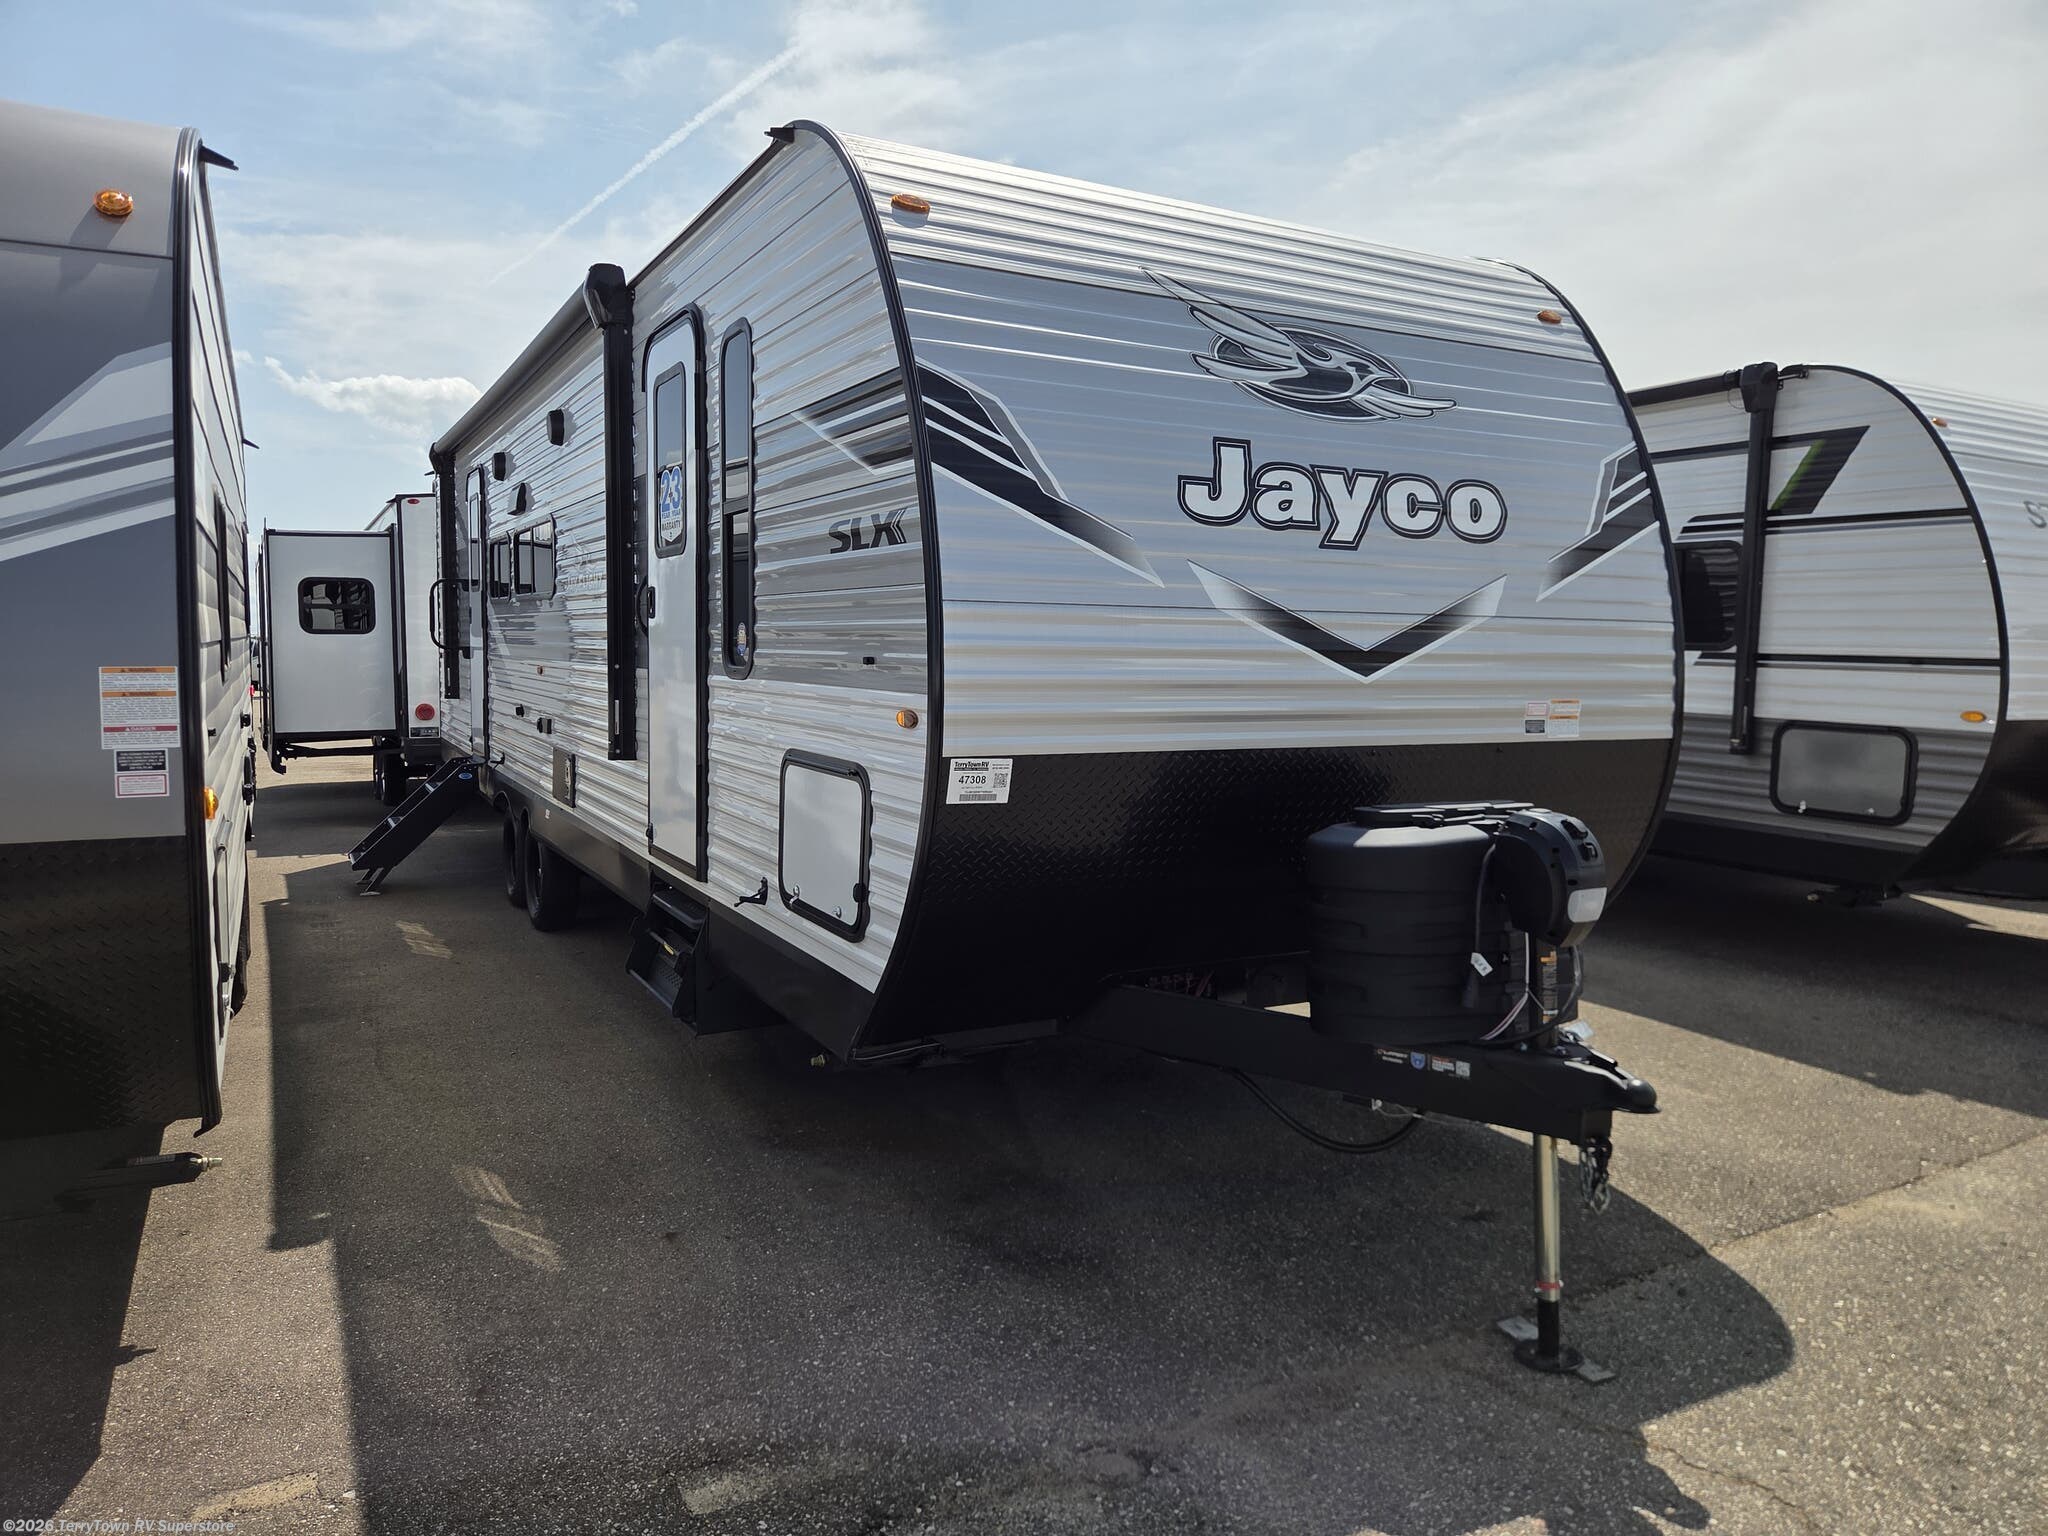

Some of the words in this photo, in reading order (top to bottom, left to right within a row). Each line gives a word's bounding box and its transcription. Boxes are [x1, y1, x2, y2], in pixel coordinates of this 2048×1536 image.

[1177, 436, 1508, 550] Jayco
[661, 520, 681, 532] WARRANTY
[828, 507, 907, 554] SLX
[958, 775, 987, 784] 47308
